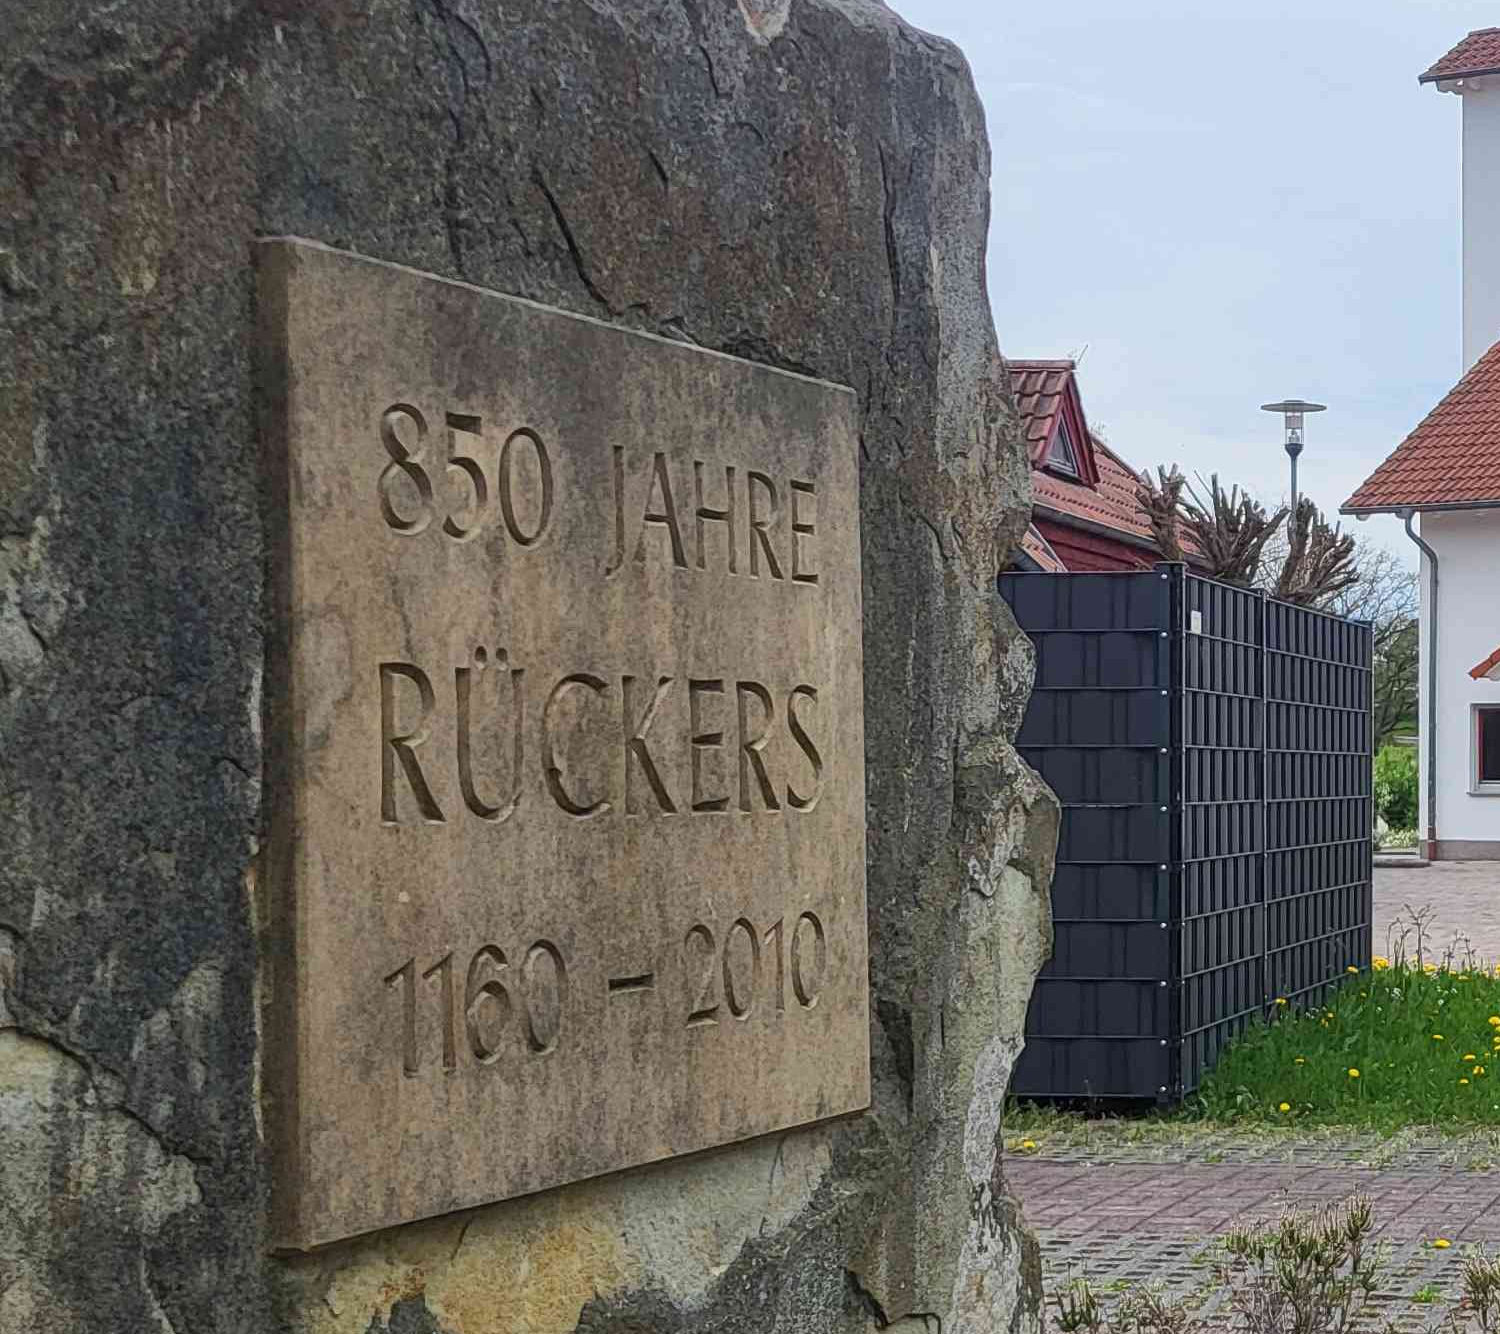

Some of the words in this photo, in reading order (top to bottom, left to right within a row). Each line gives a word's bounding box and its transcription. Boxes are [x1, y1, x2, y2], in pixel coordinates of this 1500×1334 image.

[376, 401, 556, 548] 850
[604, 443, 821, 586] JAHRE
[376, 644, 825, 828] RÜCKERS
[383, 938, 573, 1077] 1160
[682, 909, 828, 1028] 2010
